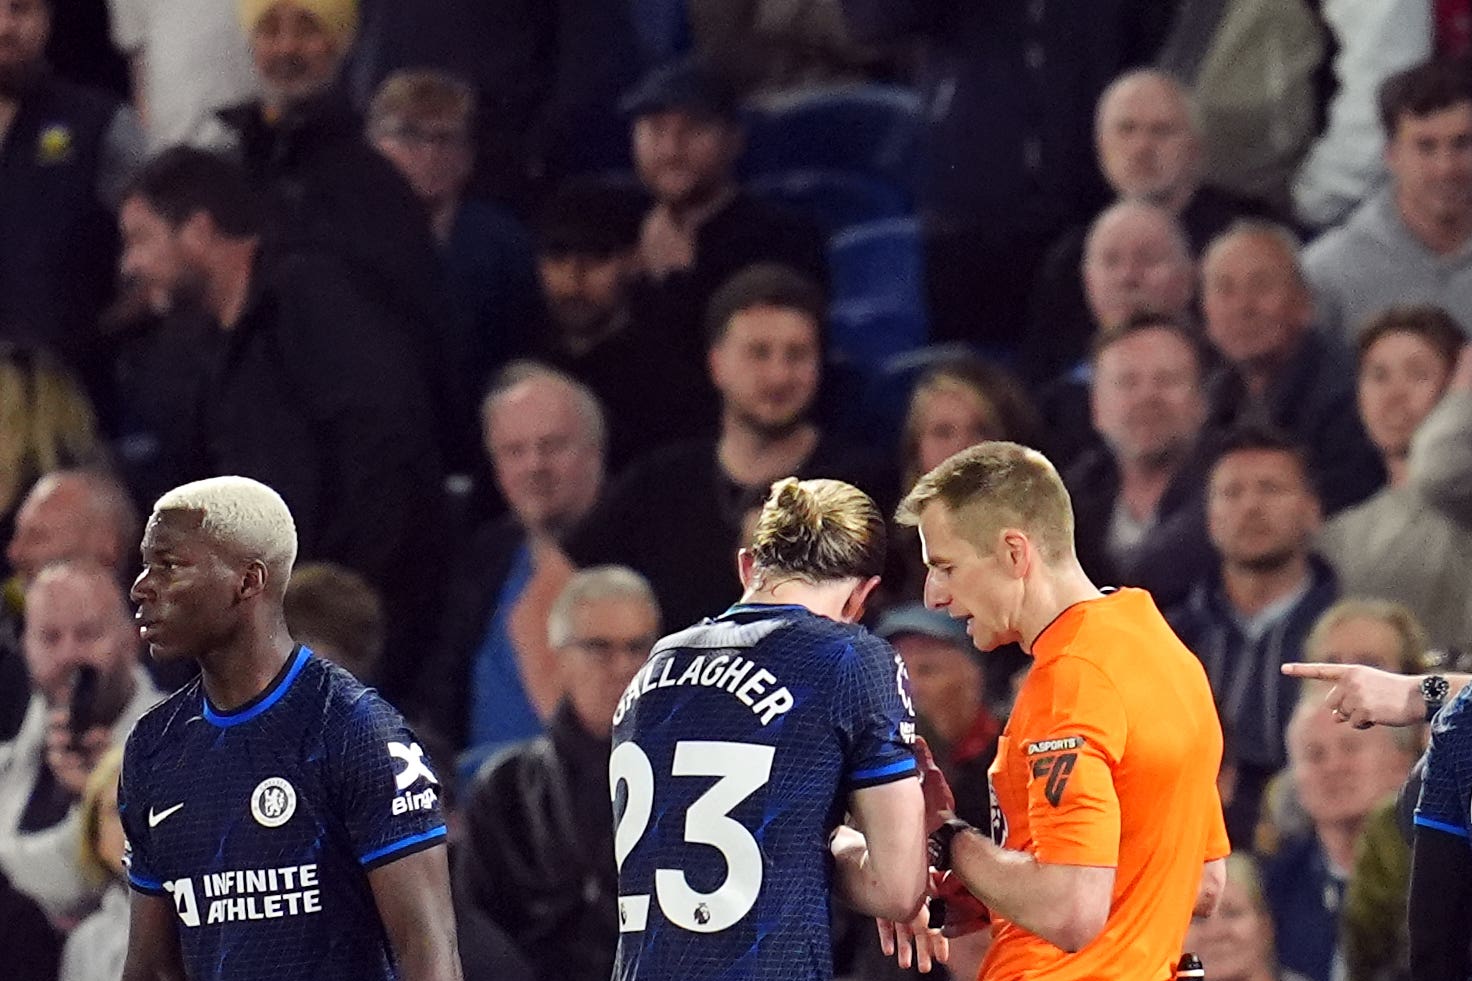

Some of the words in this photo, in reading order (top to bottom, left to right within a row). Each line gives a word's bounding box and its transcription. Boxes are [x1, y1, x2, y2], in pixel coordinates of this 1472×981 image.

[612, 654, 794, 726] GALLAGHER
[1039, 738, 1076, 752] SPORTS
[609, 740, 776, 934] 23
[203, 864, 319, 898] INFINITE
[207, 889, 322, 925] ATHLETE
